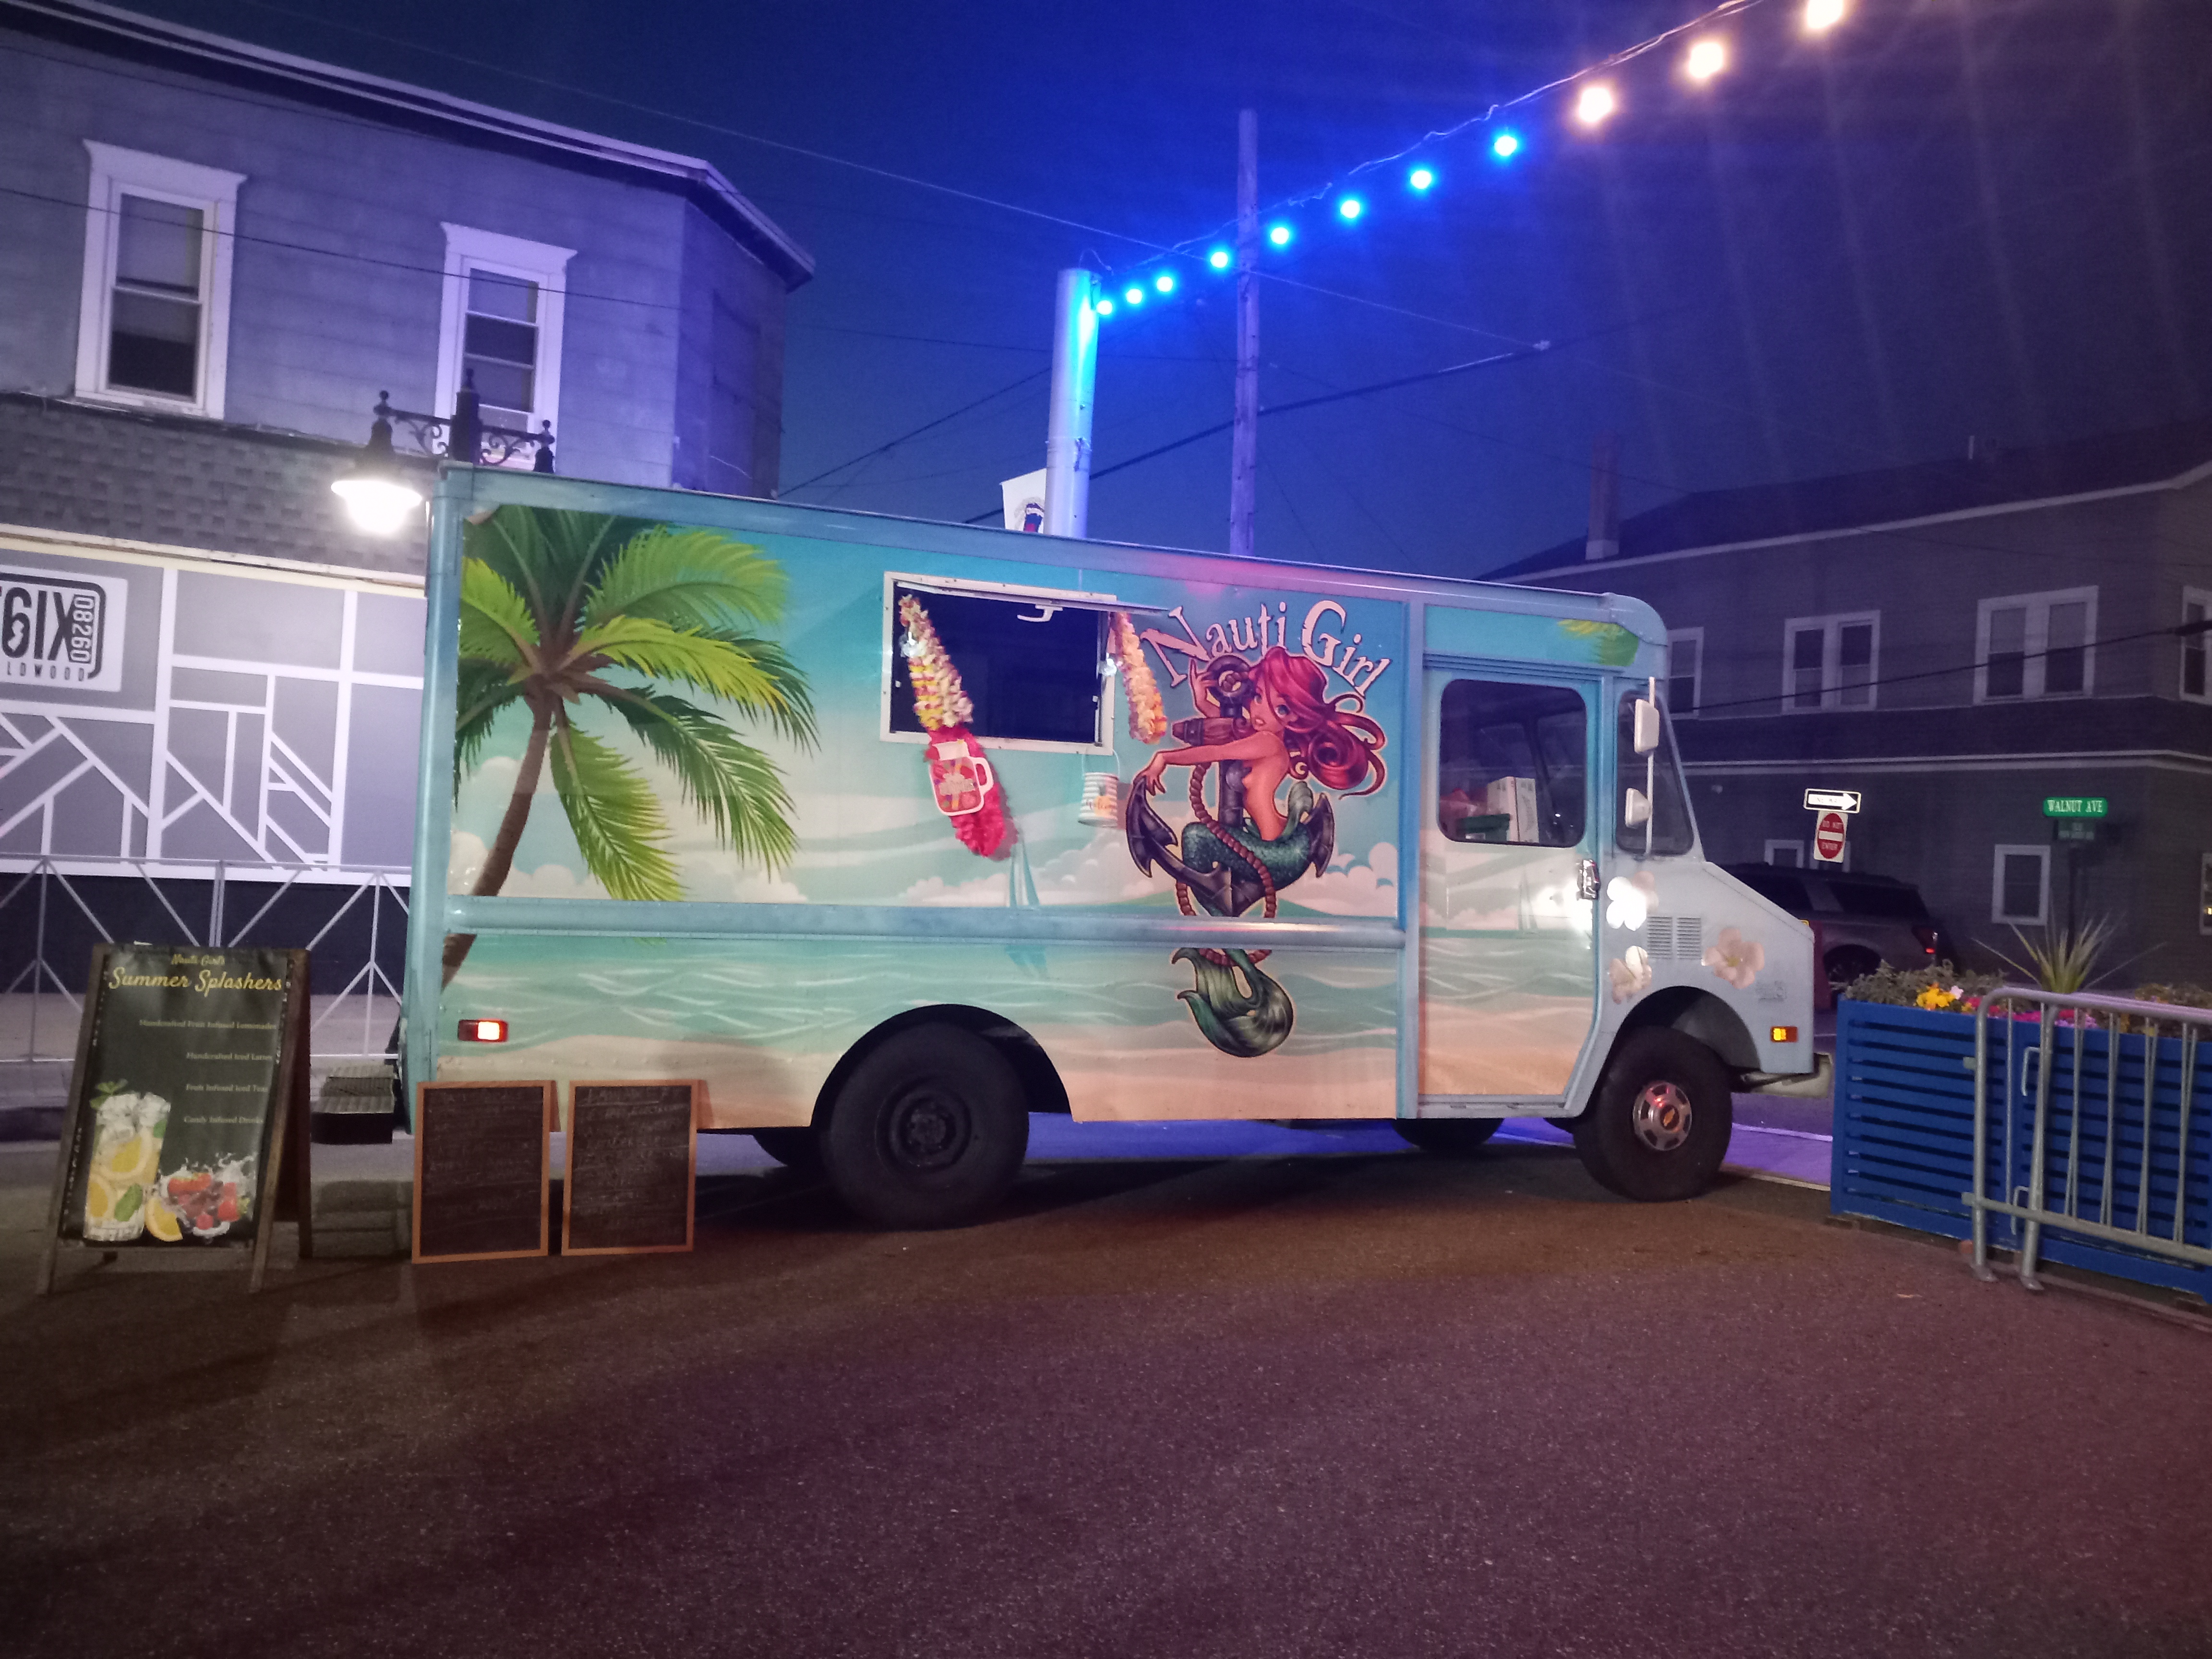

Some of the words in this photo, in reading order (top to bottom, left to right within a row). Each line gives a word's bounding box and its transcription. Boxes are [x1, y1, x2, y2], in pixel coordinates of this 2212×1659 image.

[70, 596, 95, 662] 08260
[1140, 601, 1287, 688] Nauti
[1301, 600, 1391, 699] Girl
[2047, 799, 2082, 812] WALNUT
[2085, 800, 2103, 813] AVE
[109, 966, 189, 989] Summer
[195, 969, 282, 998] Splashers
